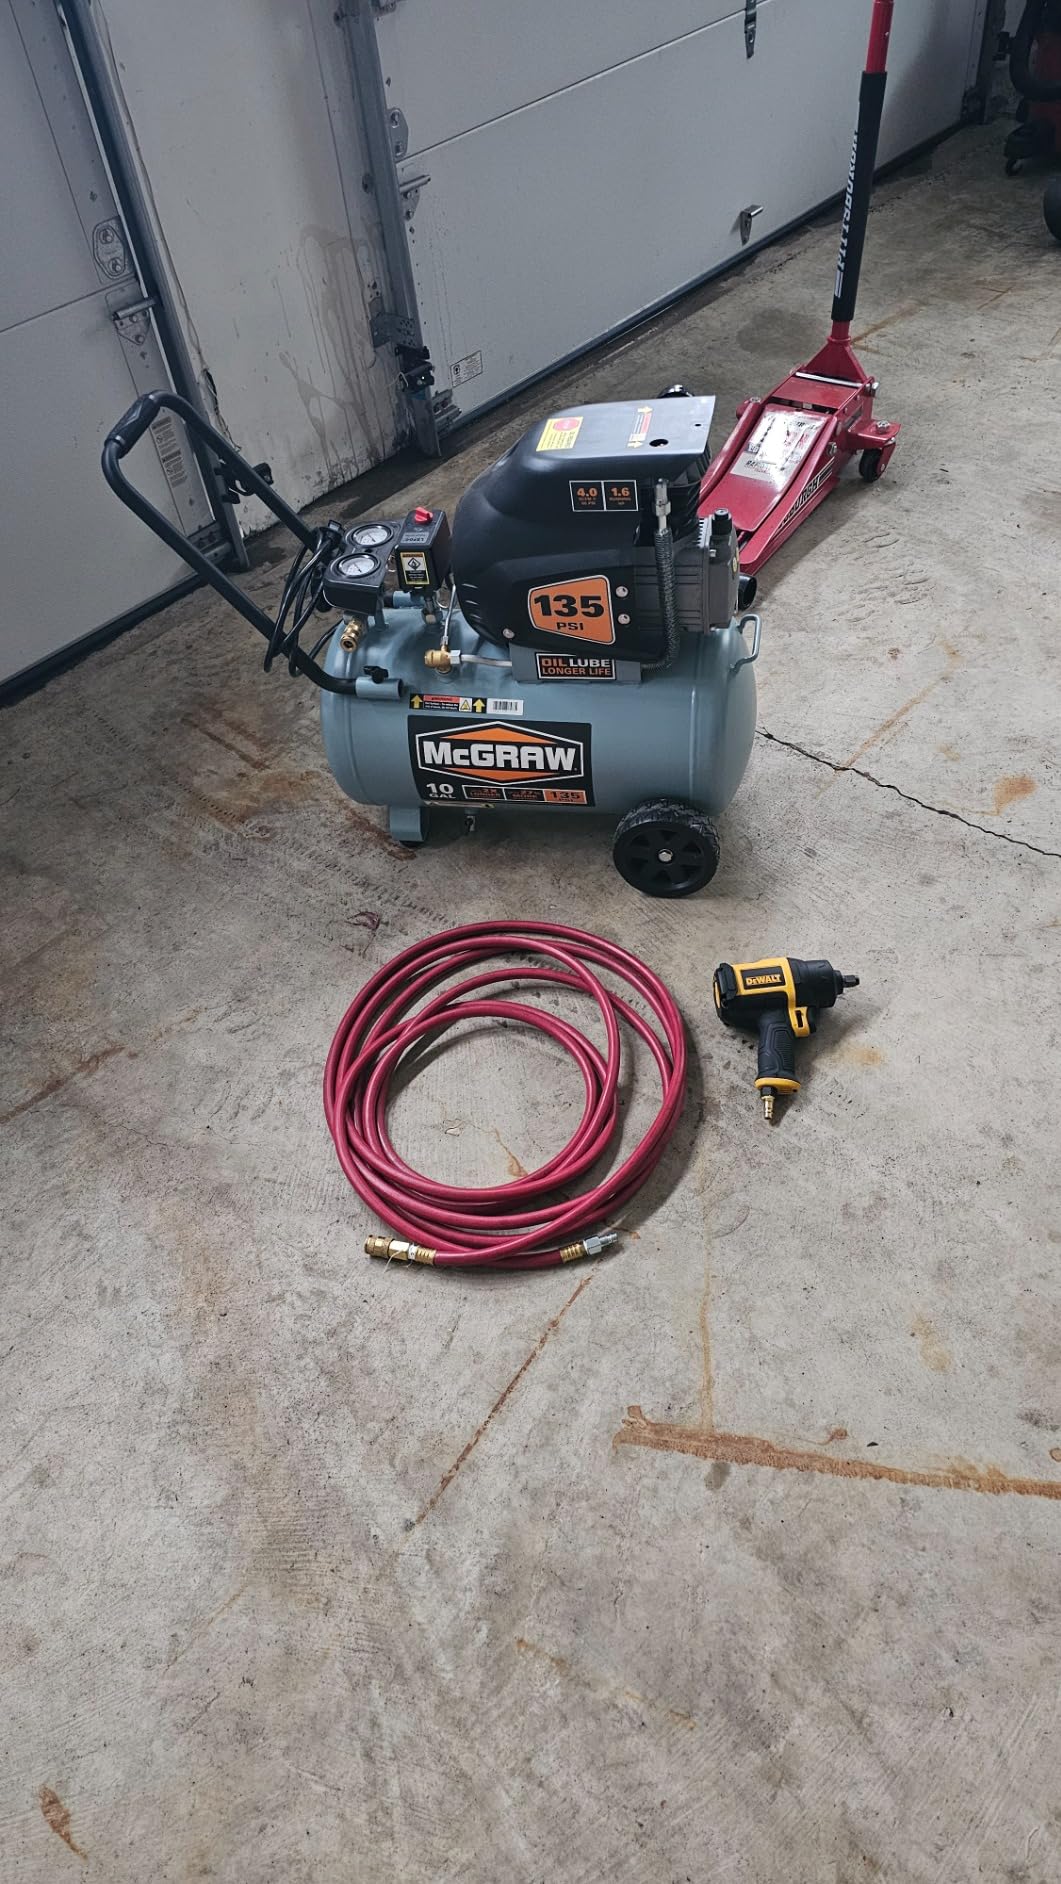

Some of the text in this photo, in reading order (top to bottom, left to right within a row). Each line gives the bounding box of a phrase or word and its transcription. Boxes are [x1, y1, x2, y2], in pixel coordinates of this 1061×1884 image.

[577, 487, 598, 497] 4.0
[611, 487, 630, 497] 1.6
[533, 594, 605, 618] 135
[556, 622, 584, 631] PSI
[541, 658, 611, 668] OIL LUBE
[542, 667, 612, 676] LONGER LIFE
[422, 740, 578, 772] McGRAW
[426, 782, 455, 794] 10
[550, 790, 581, 800] 135
